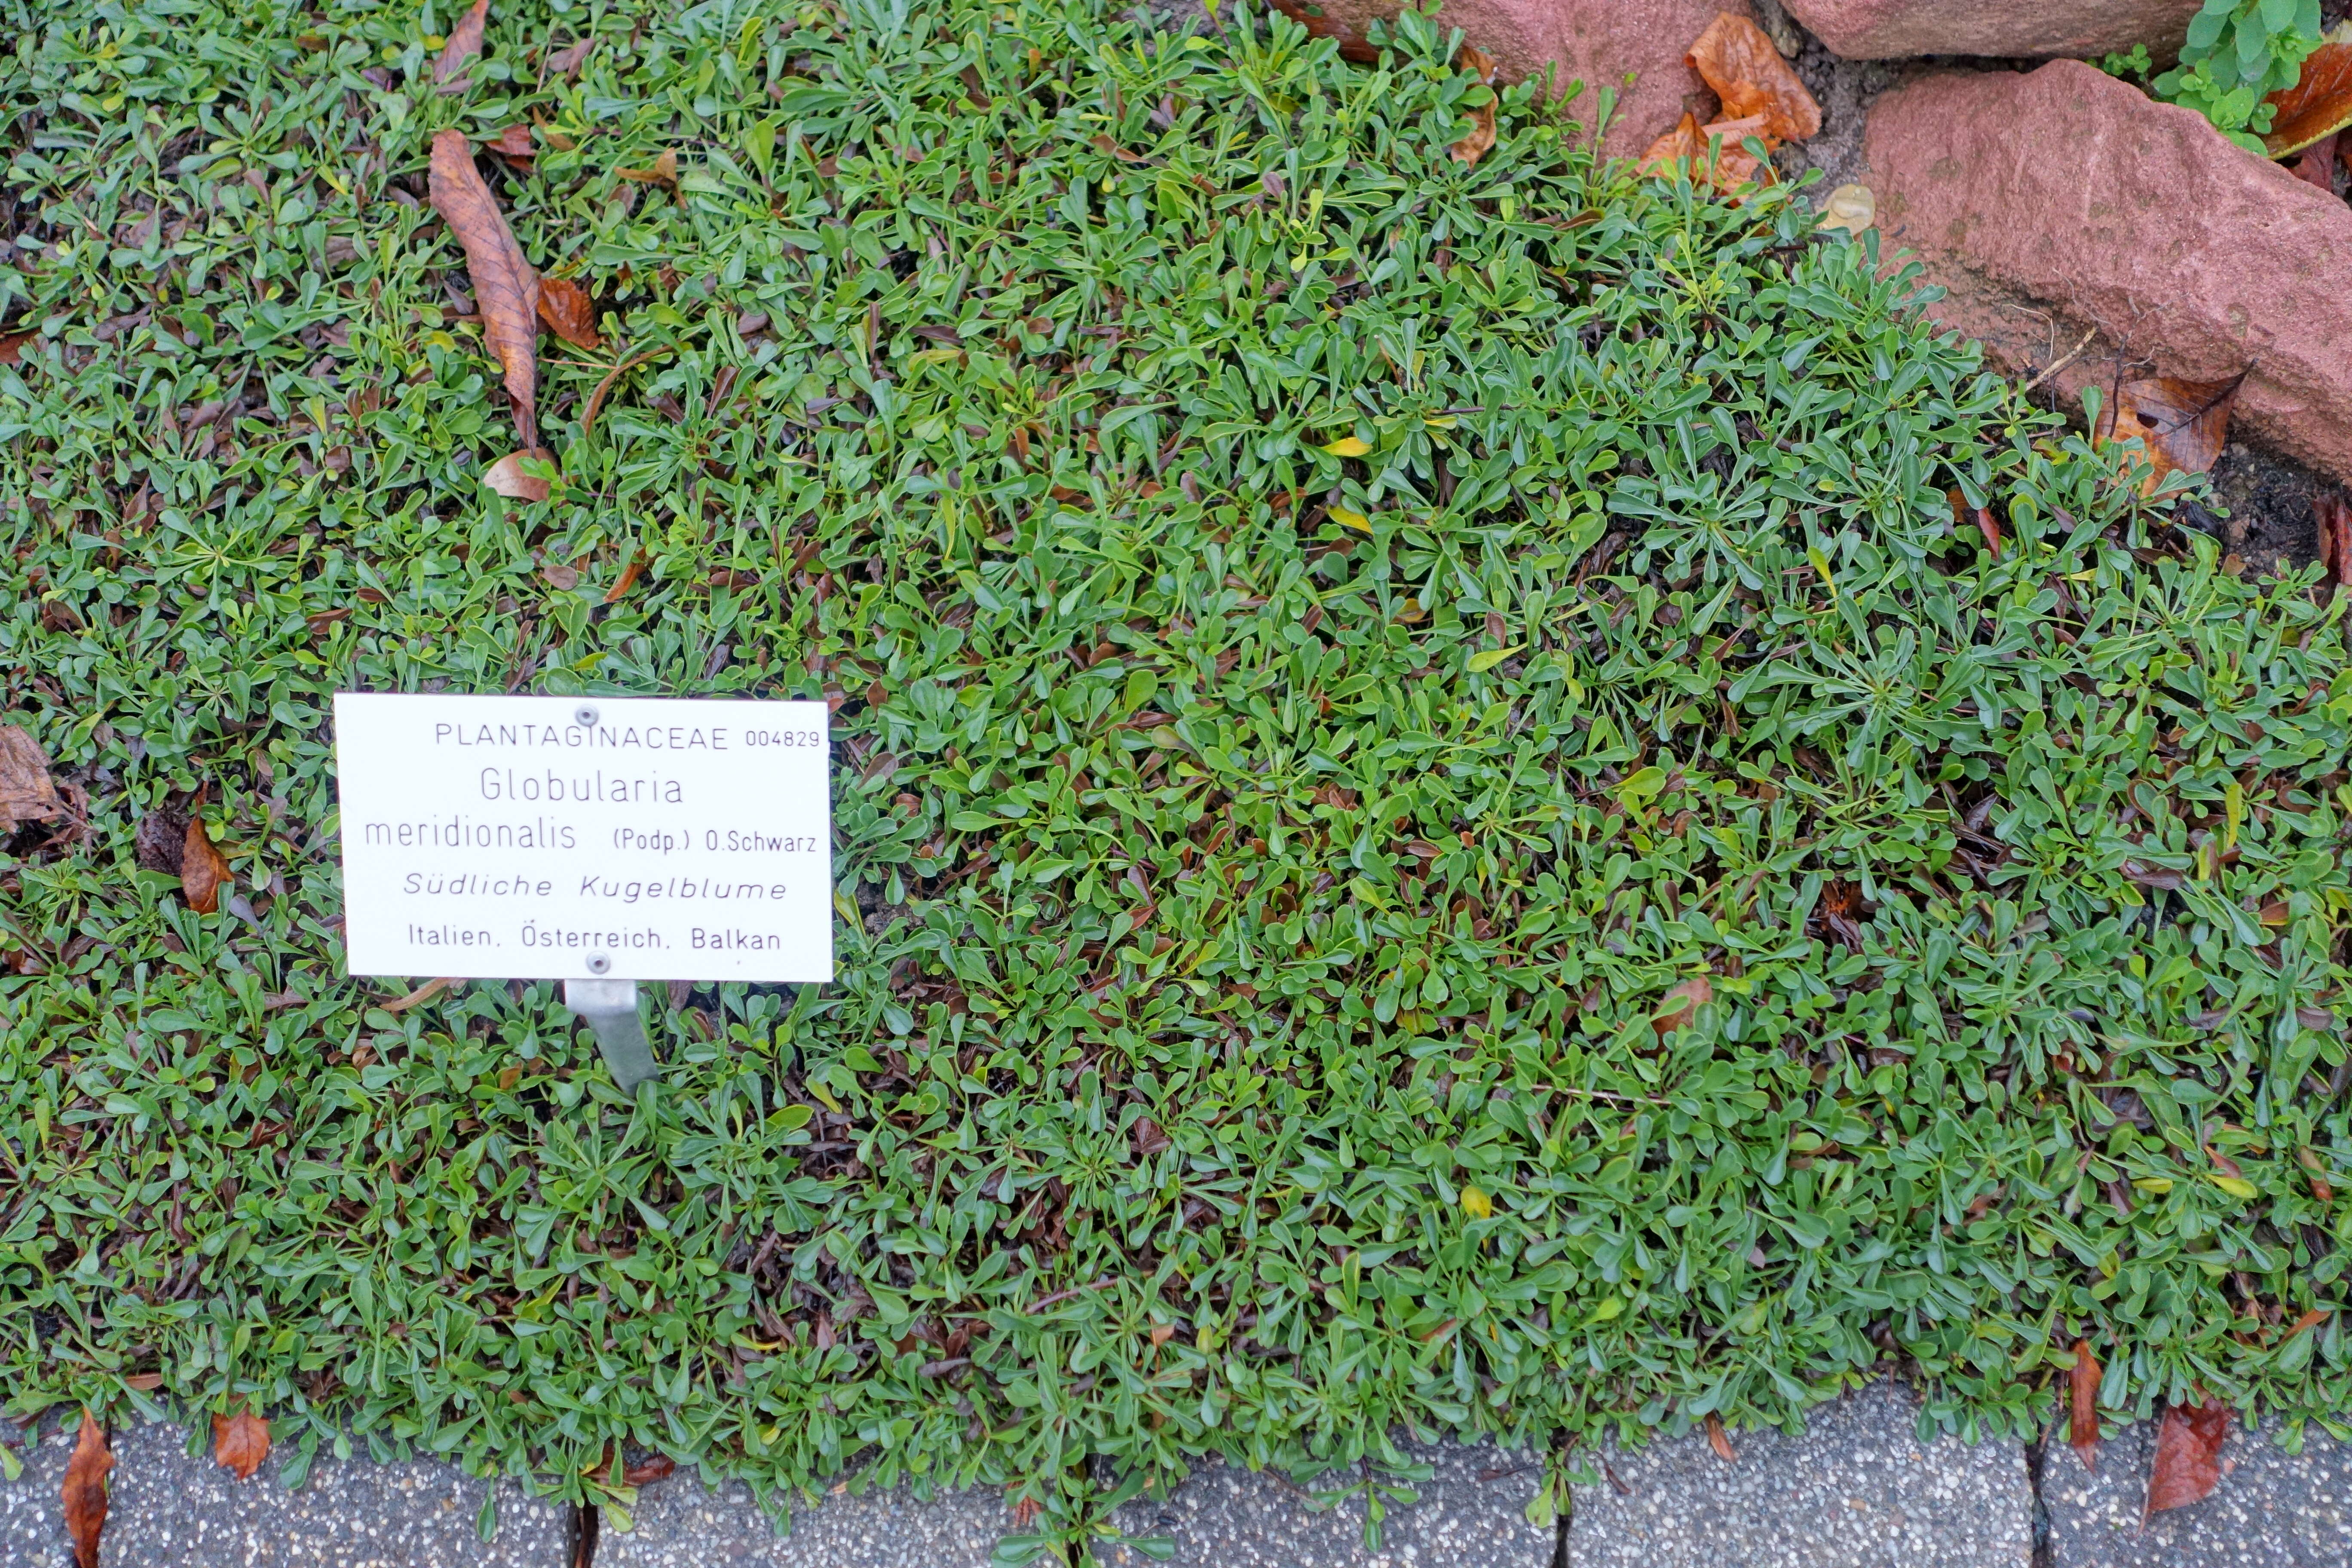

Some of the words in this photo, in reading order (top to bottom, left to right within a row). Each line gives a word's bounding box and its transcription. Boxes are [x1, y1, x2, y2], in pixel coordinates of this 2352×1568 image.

[436, 723, 728, 750] PLANTAGINACEAE
[746, 730, 819, 747] 004829
[481, 767, 683, 803] Globularia
[366, 815, 575, 849] meridionalis
[614, 828, 689, 855] (Podp.)
[404, 873, 551, 896] Südliche
[580, 876, 786, 903] Kugelblume
[692, 928, 780, 950] Balkan
